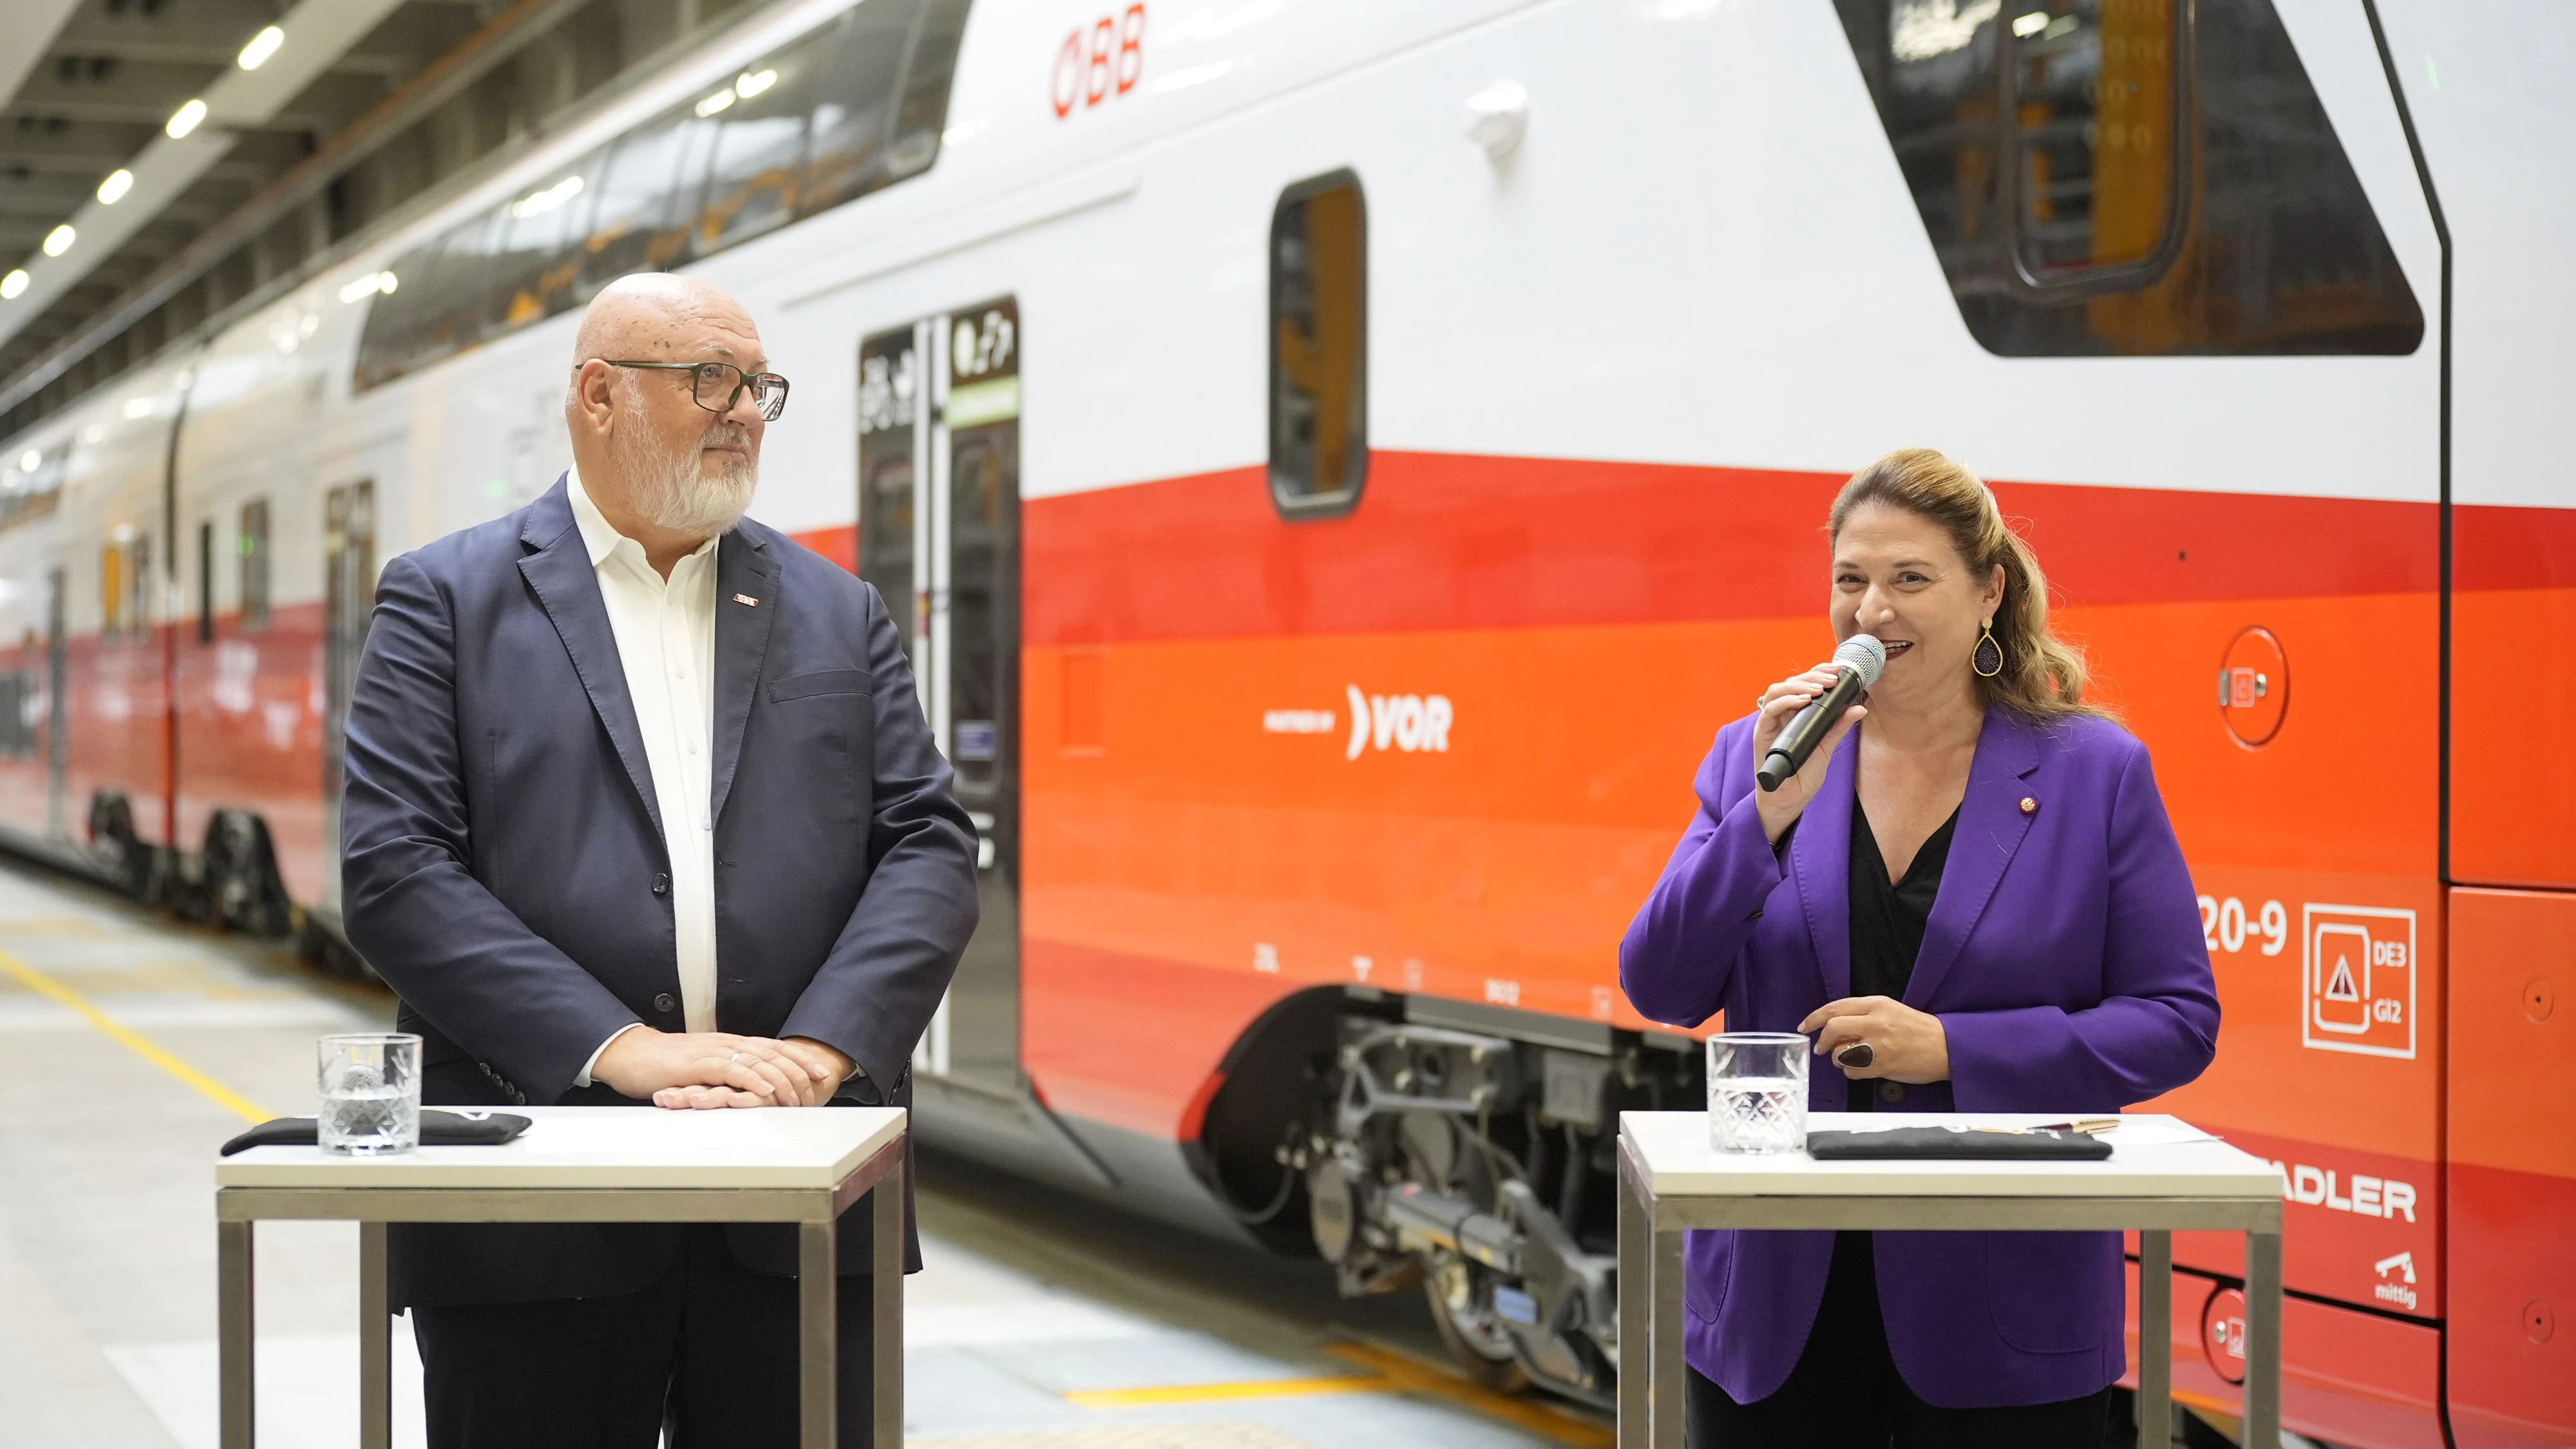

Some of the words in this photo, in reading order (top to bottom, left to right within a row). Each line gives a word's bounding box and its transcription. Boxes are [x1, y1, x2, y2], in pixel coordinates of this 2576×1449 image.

[1372, 694, 1454, 752] VOR
[2373, 940, 2407, 968] DE3
[2374, 1282, 2417, 1310] mittig
